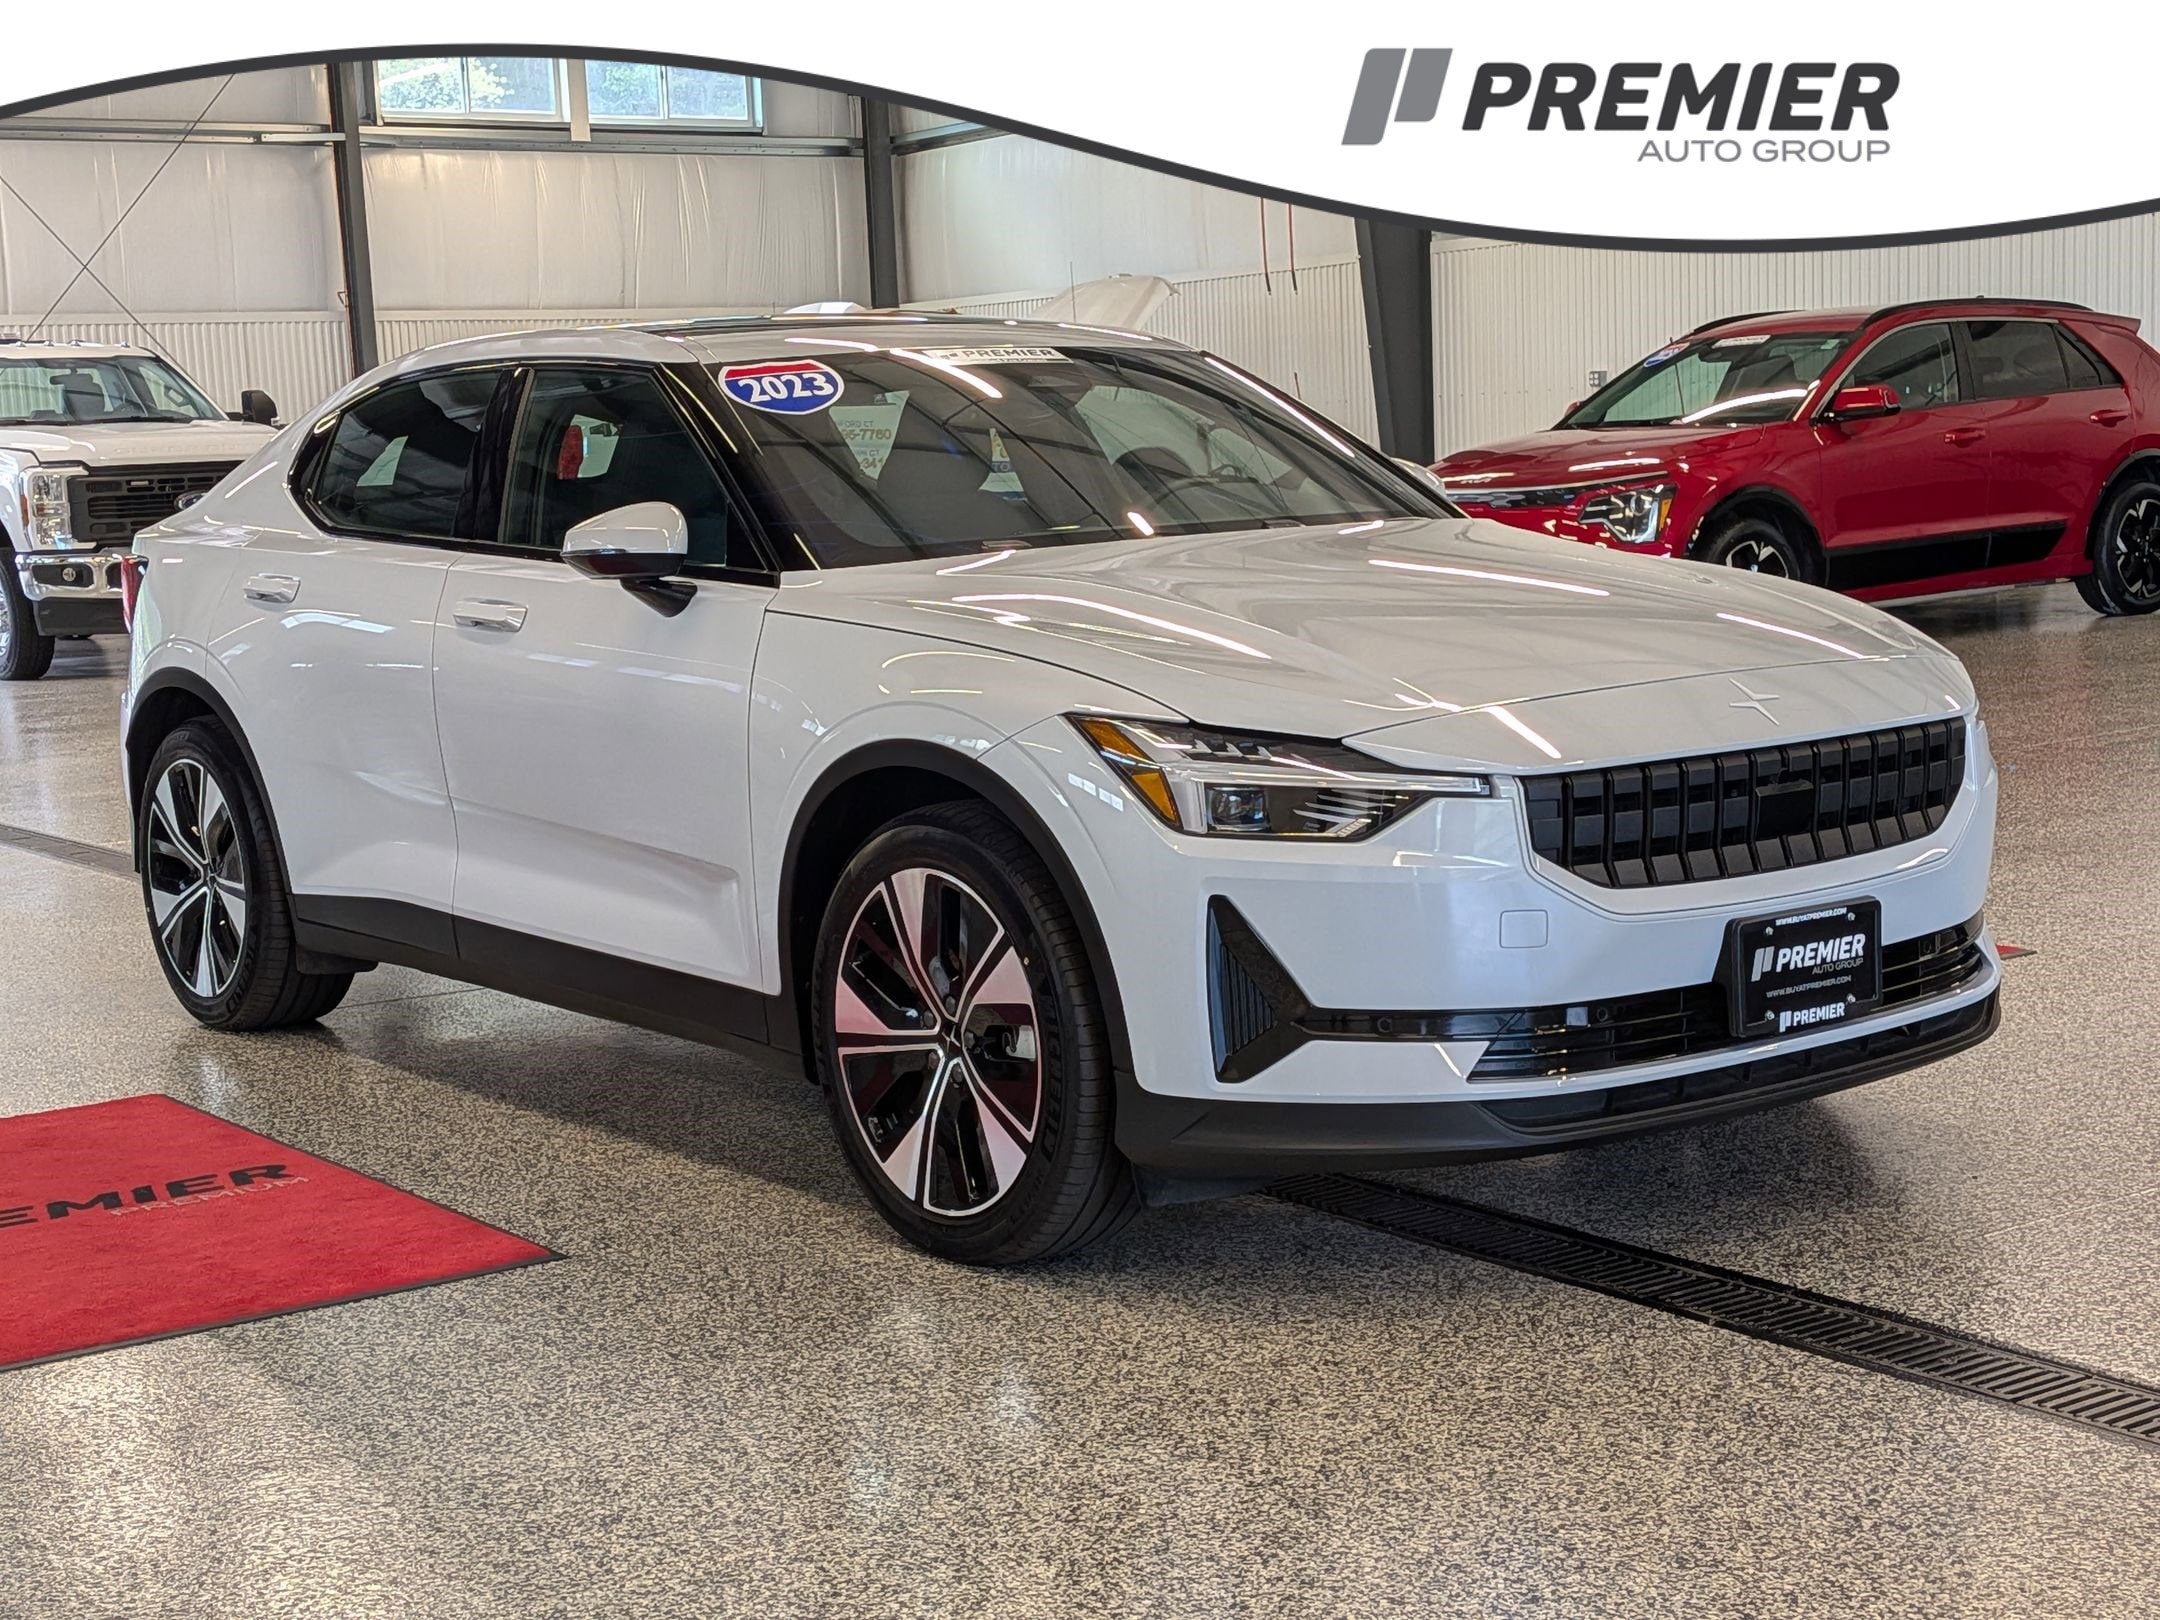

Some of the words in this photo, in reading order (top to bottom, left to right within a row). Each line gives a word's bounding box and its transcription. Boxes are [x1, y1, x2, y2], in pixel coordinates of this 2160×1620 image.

[963, 347, 1055, 359] PREMIER
[737, 372, 835, 403] 2023
[1775, 932, 1867, 973] PREMIER
[1811, 963, 1835, 976] AUTO
[1835, 957, 1864, 971] GROUP
[1792, 1001, 1846, 1027] PREMIER
